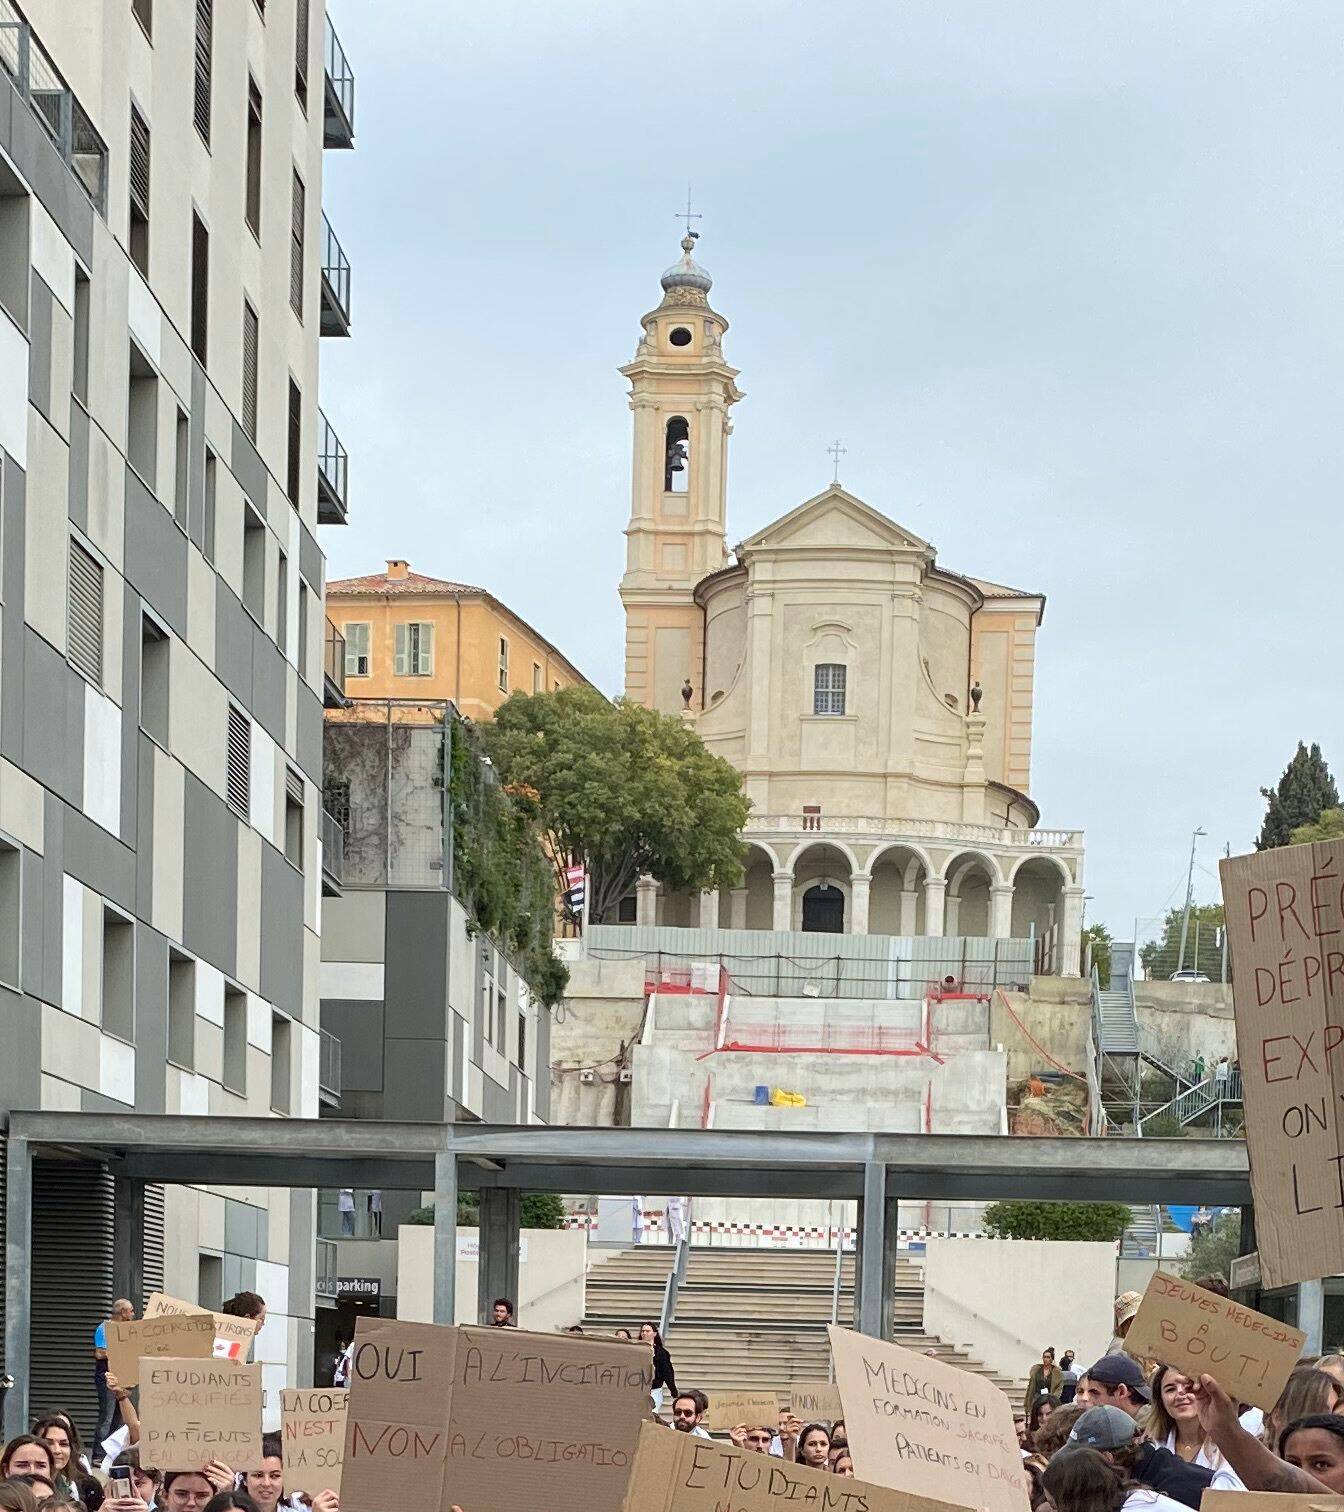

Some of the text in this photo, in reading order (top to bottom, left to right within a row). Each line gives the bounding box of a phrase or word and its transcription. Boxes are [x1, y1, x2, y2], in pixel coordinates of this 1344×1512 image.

[1282, 1094, 1329, 1139] ON
[337, 1279, 379, 1295] parking
[151, 1369, 252, 1387] ETUDIANTS
[489, 1352, 653, 1391] L'INCITATION
[965, 1401, 986, 1418] EN
[148, 1430, 252, 1443] PATIENTS
[285, 1420, 341, 1440] N'EST
